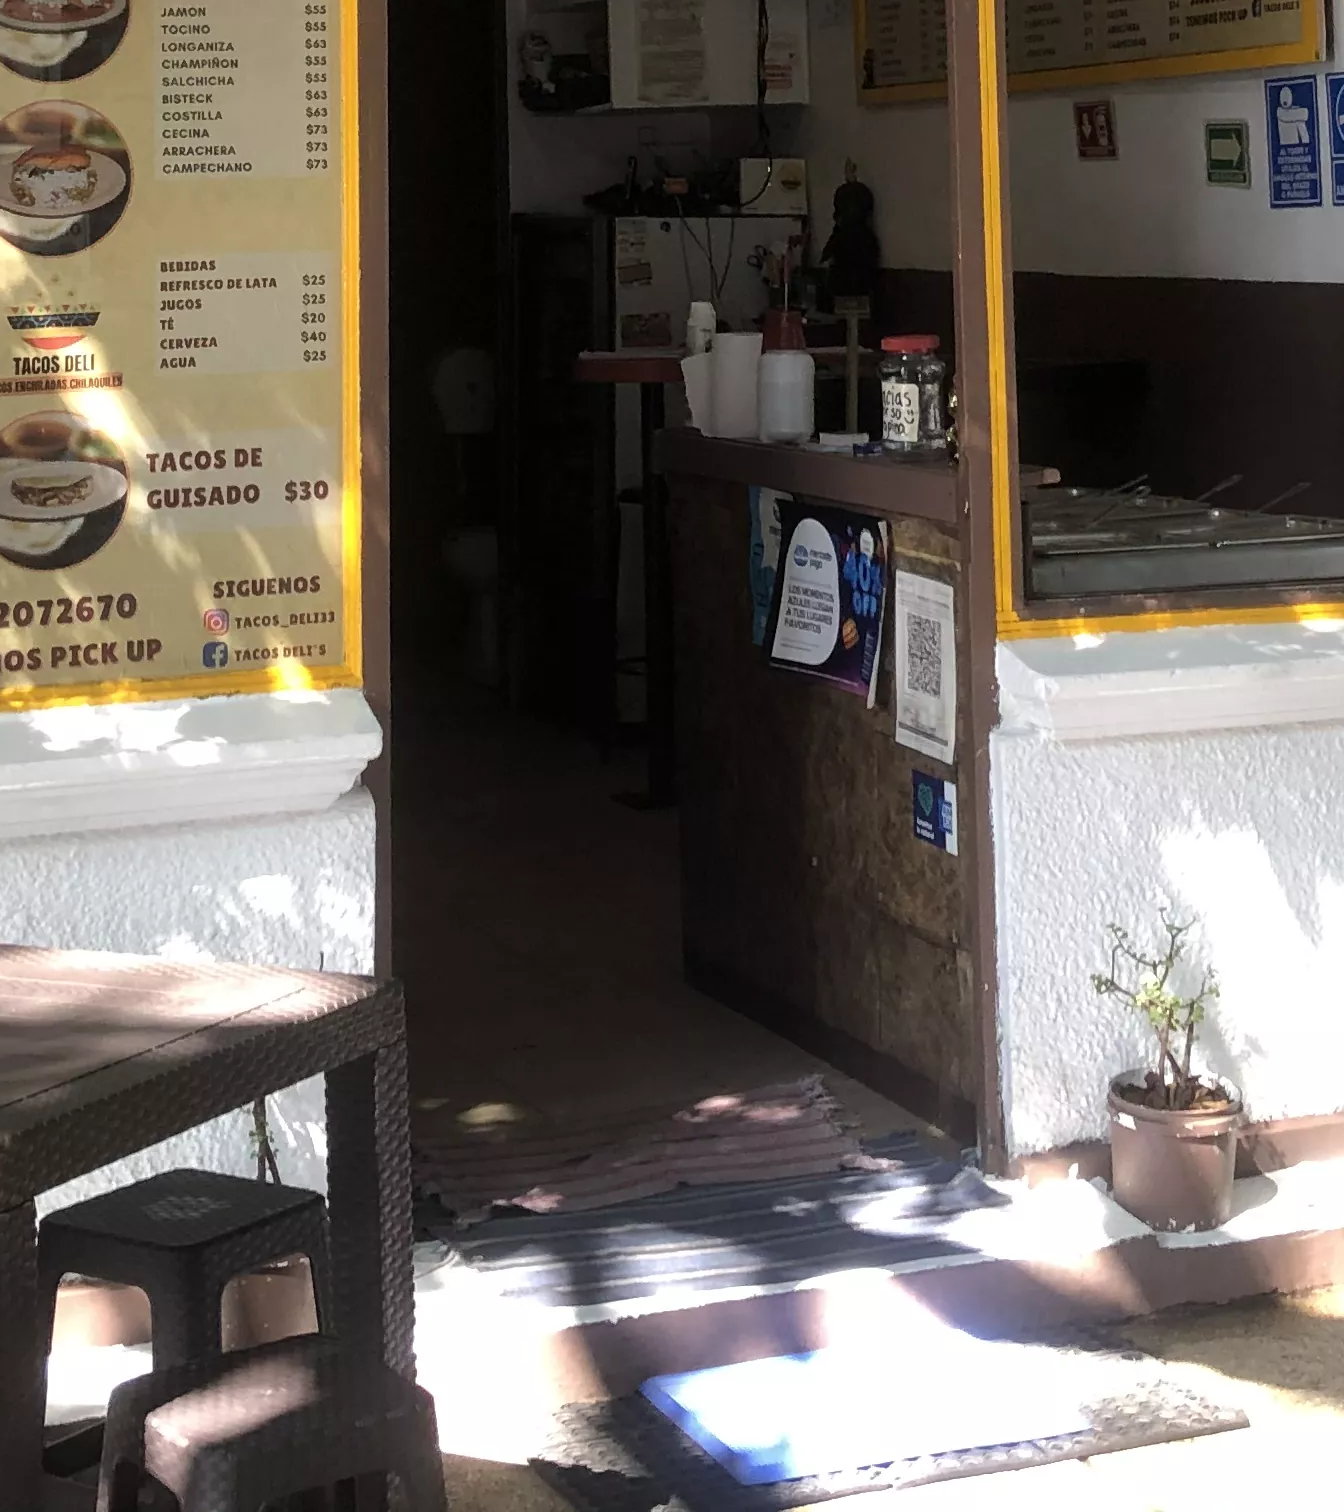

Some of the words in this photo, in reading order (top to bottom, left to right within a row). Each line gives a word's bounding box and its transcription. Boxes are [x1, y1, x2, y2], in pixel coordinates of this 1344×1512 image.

[160, 7, 206, 18] JAMON
[304, 3, 327, 16] $55
[160, 24, 211, 36] TOCINO
[304, 20, 327, 33] $55
[161, 56, 239, 70] CHAMPIÑON
[305, 55, 327, 67] $55
[160, 260, 217, 273] BEBIDAS
[160, 279, 224, 292] REFRESCO
[226, 278, 243, 290] DE
[245, 277, 278, 289] LATA
[302, 273, 326, 287] $25
[159, 298, 202, 312] JUGOS
[302, 292, 326, 307] $25
[159, 336, 218, 350] CERVEZA
[300, 330, 327, 344] $40
[13, 355, 61, 376] TACOS
[64, 353, 95, 373] DELI
[145, 449, 227, 473] TACOS
[234, 447, 263, 468] DE
[144, 484, 261, 511] GUISADO
[284, 480, 329, 503] $30
[212, 575, 321, 600] SIGUENOS
[51, 641, 119, 668] PICK
[126, 638, 162, 662] UP
[234, 647, 279, 662] TACOS
